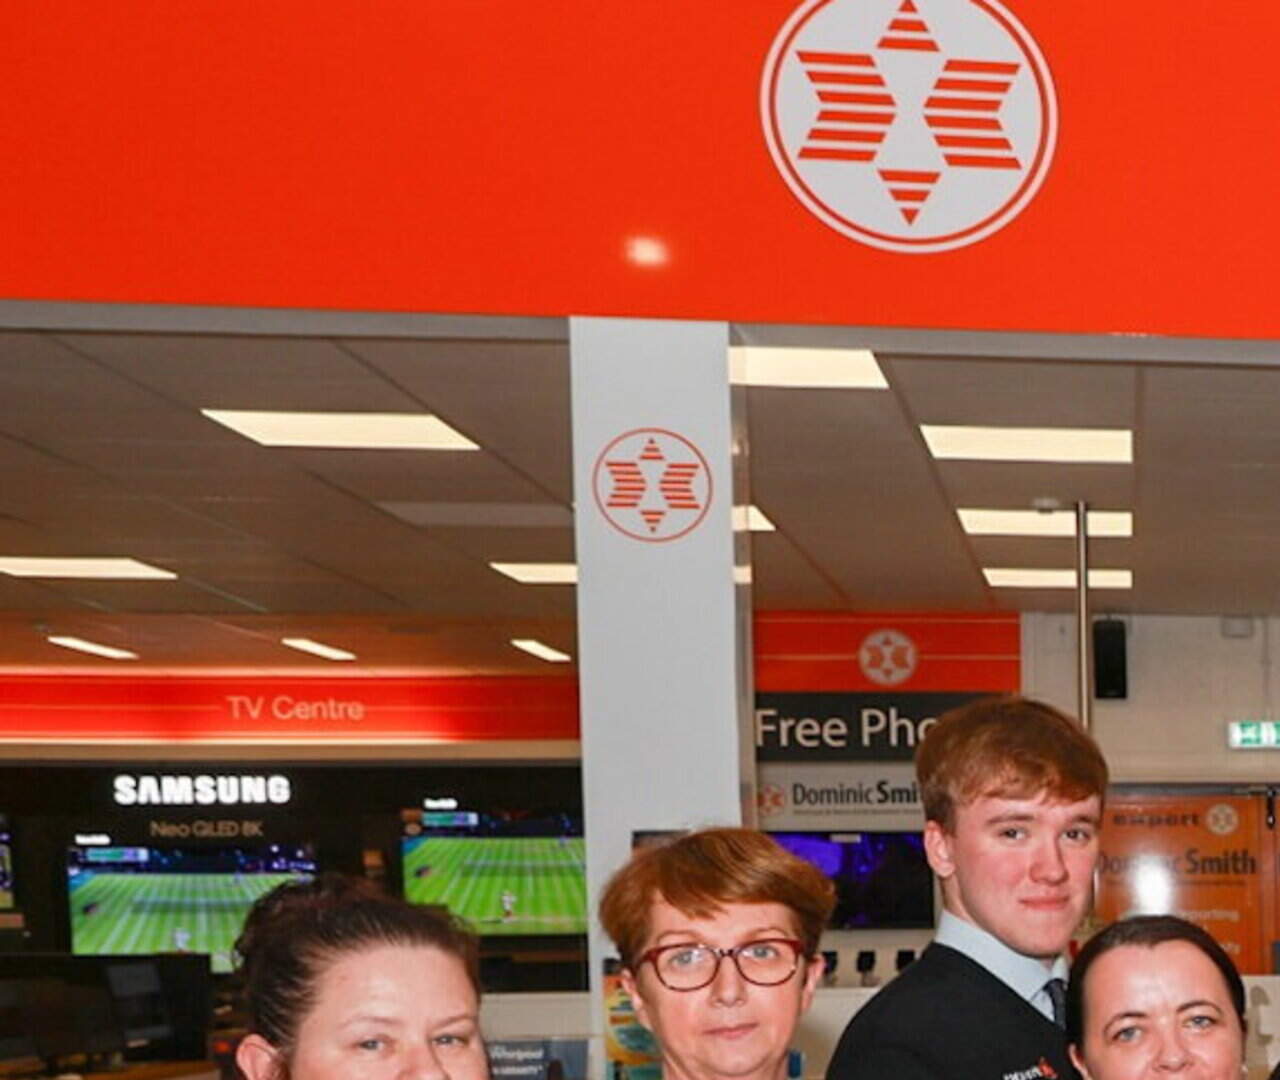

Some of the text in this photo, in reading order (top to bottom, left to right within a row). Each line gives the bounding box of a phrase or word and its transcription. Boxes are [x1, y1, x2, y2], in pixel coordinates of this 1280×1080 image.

[226, 695, 366, 721] TV Centre
[755, 709, 848, 748] Free
[113, 773, 291, 805] SAMSUNG
[792, 781, 874, 806] Dominic
[150, 820, 191, 838] Neo
[192, 820, 240, 838] QLED
[1185, 847, 1257, 875] Smith
